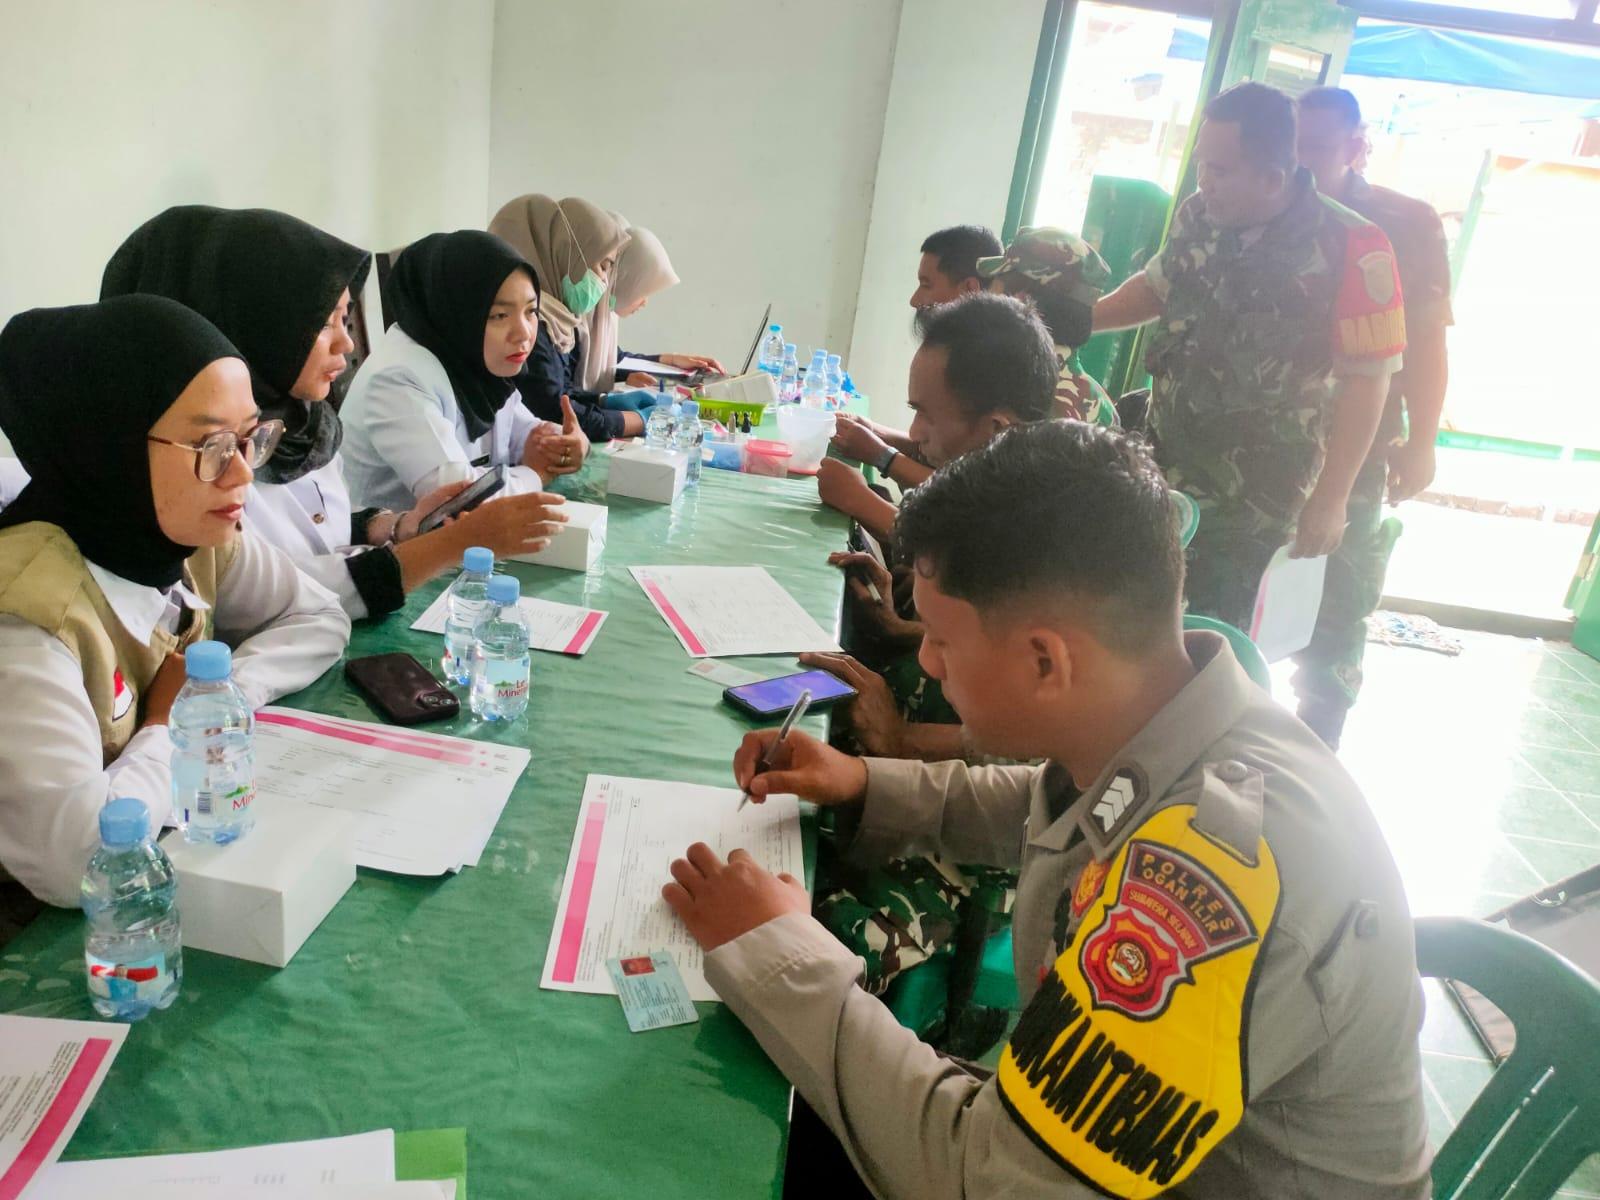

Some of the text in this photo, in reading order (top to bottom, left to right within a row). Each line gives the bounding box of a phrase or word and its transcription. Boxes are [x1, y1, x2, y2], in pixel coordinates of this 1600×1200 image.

[1141, 853, 1235, 931] POLRES
[1142, 867, 1219, 933] OGAN ILIR
